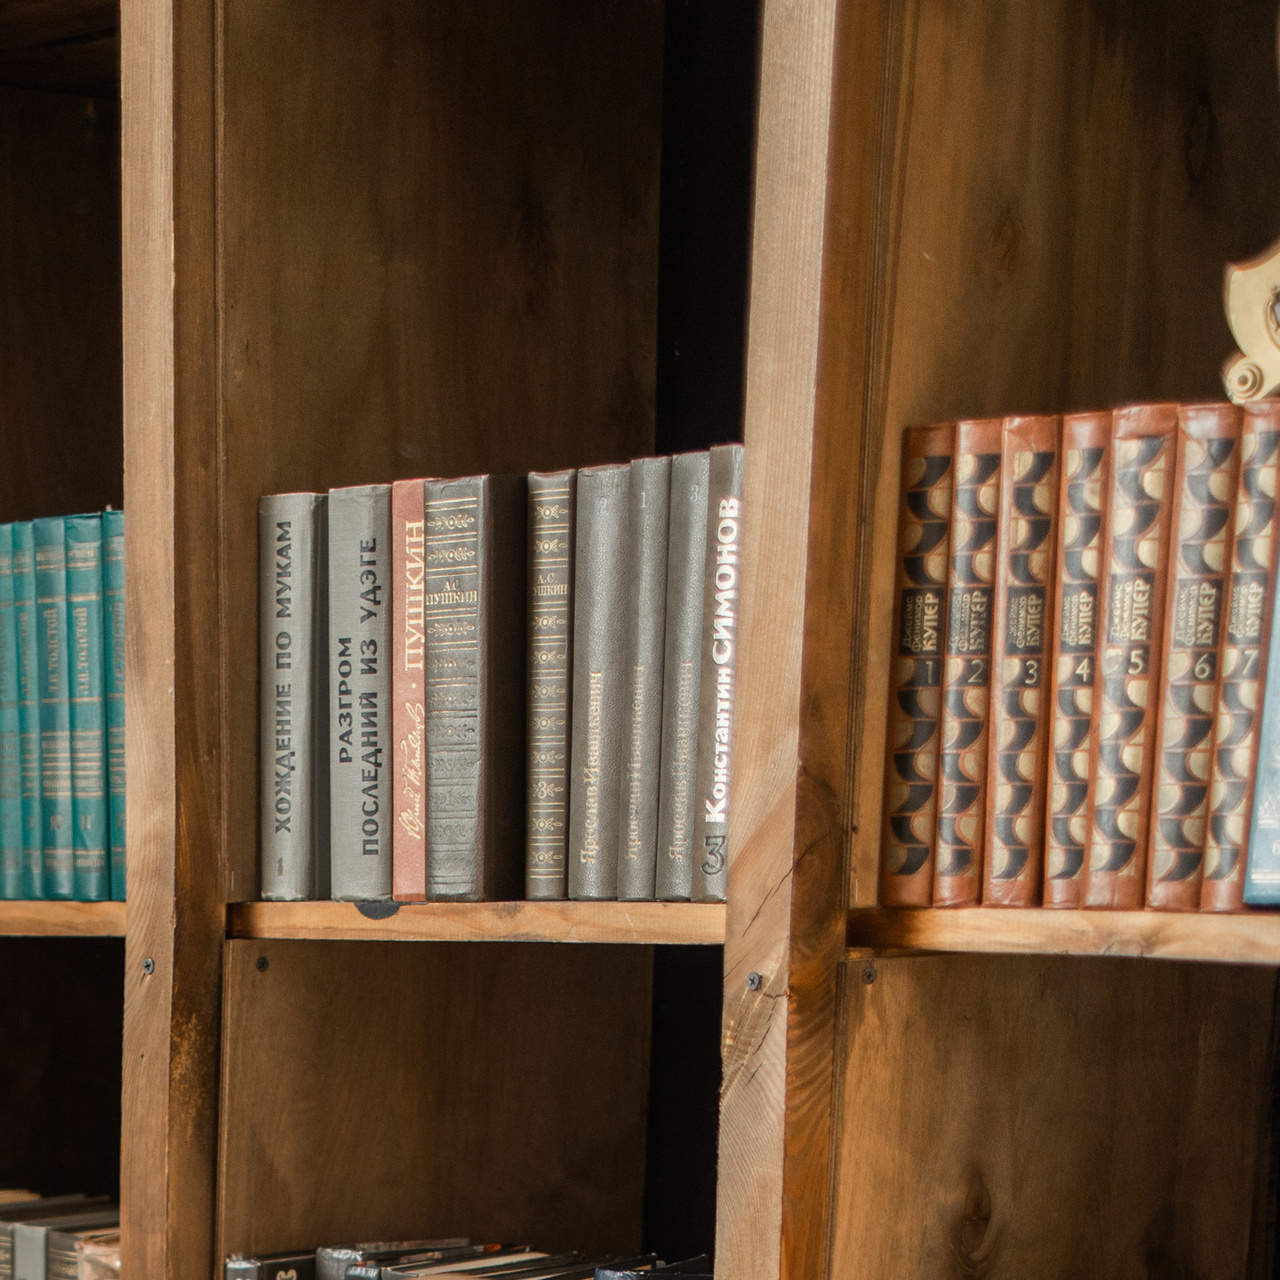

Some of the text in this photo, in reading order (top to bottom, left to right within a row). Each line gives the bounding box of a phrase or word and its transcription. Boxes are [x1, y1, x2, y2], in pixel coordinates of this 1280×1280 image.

[599, 497, 608, 514] 2
[640, 492, 647, 508] 1
[405, 519, 425, 671] ПУШКИН
[426, 589, 478, 606] ПУШКИН
[533, 583, 568, 597] УШКИН
[1131, 578, 1150, 641] КУПЕР
[1245, 580, 1264, 638] КУПЕР
[922, 592, 940, 651] КУПЕР
[1026, 594, 1042, 646] КУПЕР
[1078, 591, 1093, 645] КУПЕР
[1196, 582, 1216, 645] КУПЕР
[275, 521, 295, 834] ХОЖДЕНИЕ ПО МУКАМ
[705, 496, 740, 823] Константин СИМОНОВ
[925, 660, 933, 684] 1
[967, 659, 984, 683] 2
[1025, 660, 1039, 684] 3
[1075, 657, 1091, 682] 4
[1128, 649, 1144, 675] 5
[1194, 653, 1211, 680] 6
[1242, 649, 1259, 676] 7
[338, 637, 353, 763] РАЗГРОМ
[359, 537, 382, 856] ПОСЛЕДНИЙ ИЗ УДЭГЕ
[580, 671, 602, 864] Ярослав Ивашкевич
[701, 835, 727, 876] 3
